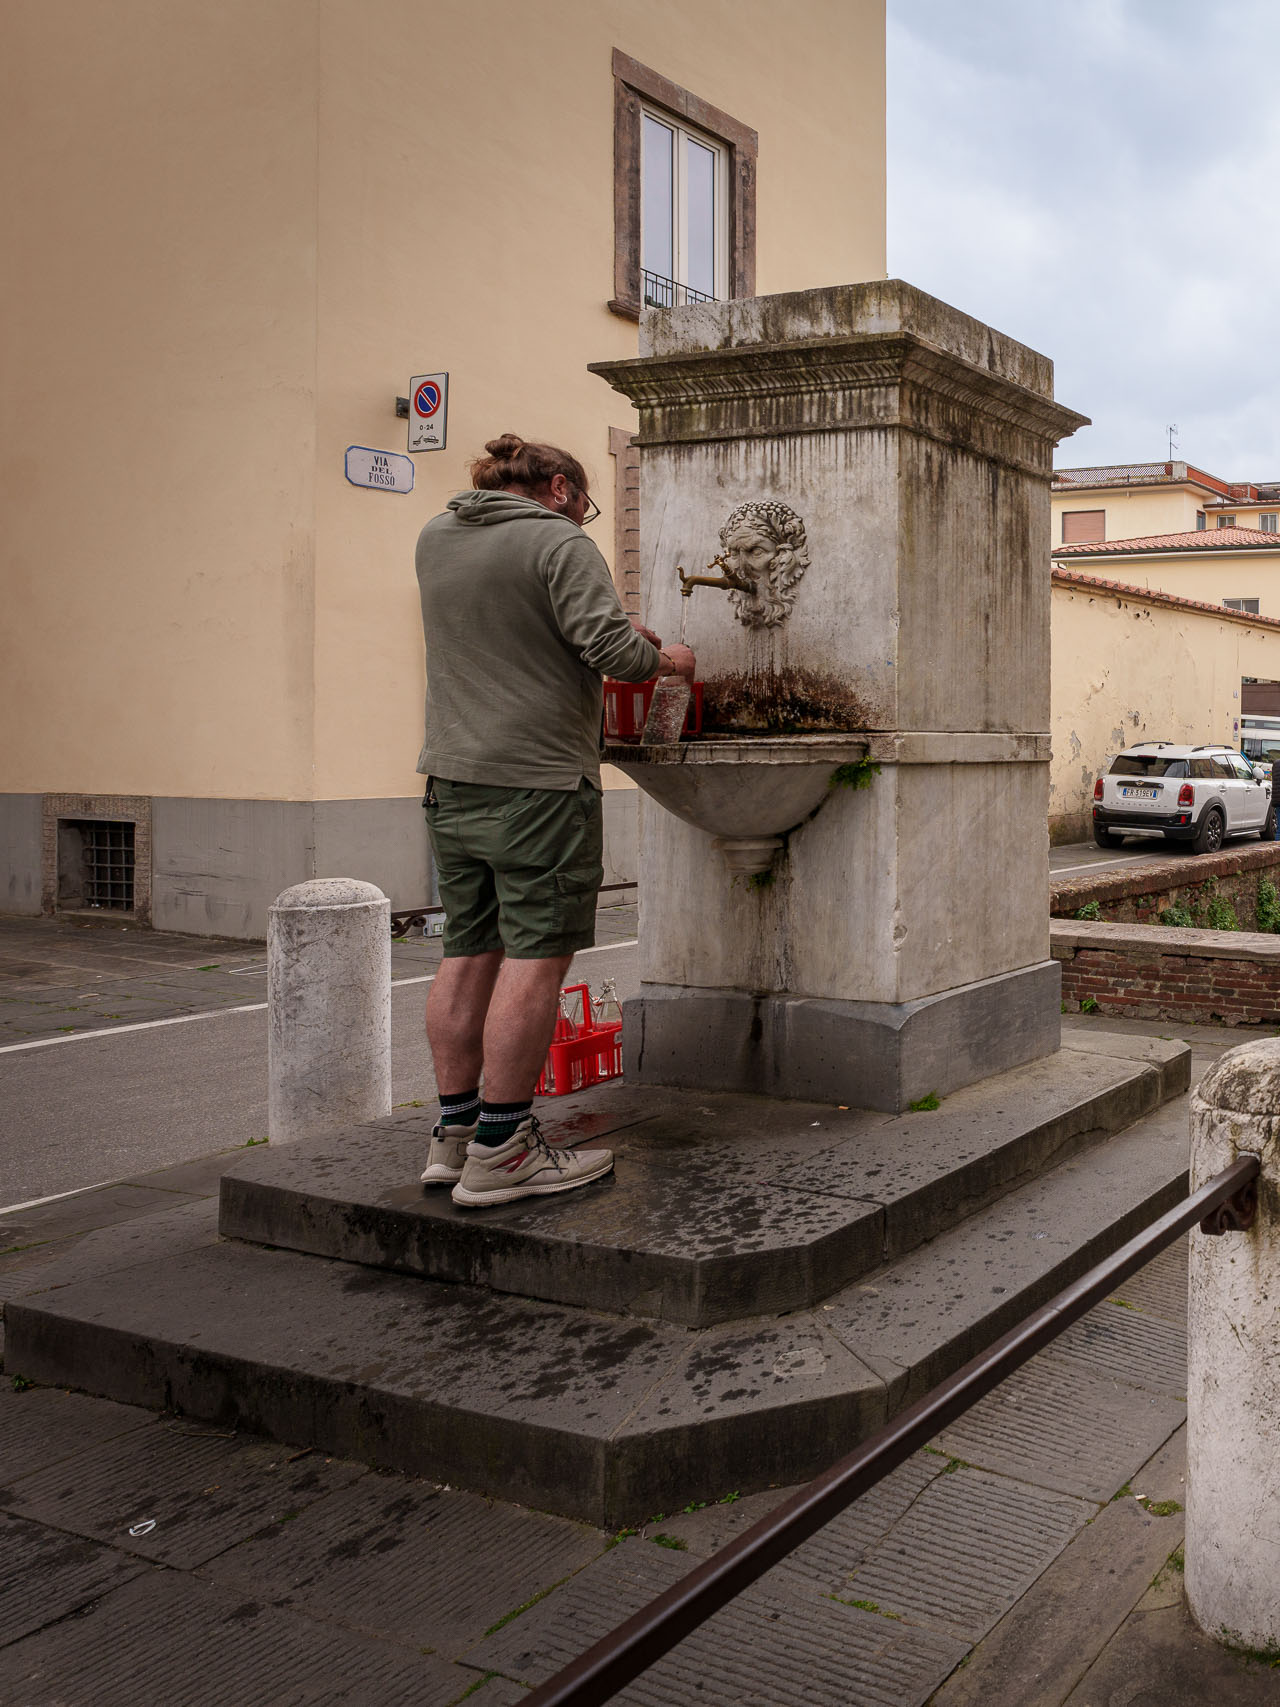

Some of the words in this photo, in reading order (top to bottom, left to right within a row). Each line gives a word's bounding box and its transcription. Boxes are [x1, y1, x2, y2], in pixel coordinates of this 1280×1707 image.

[374, 455, 389, 467] VIA
[371, 466, 392, 475] DEL
[368, 472, 395, 486] FOSSO
